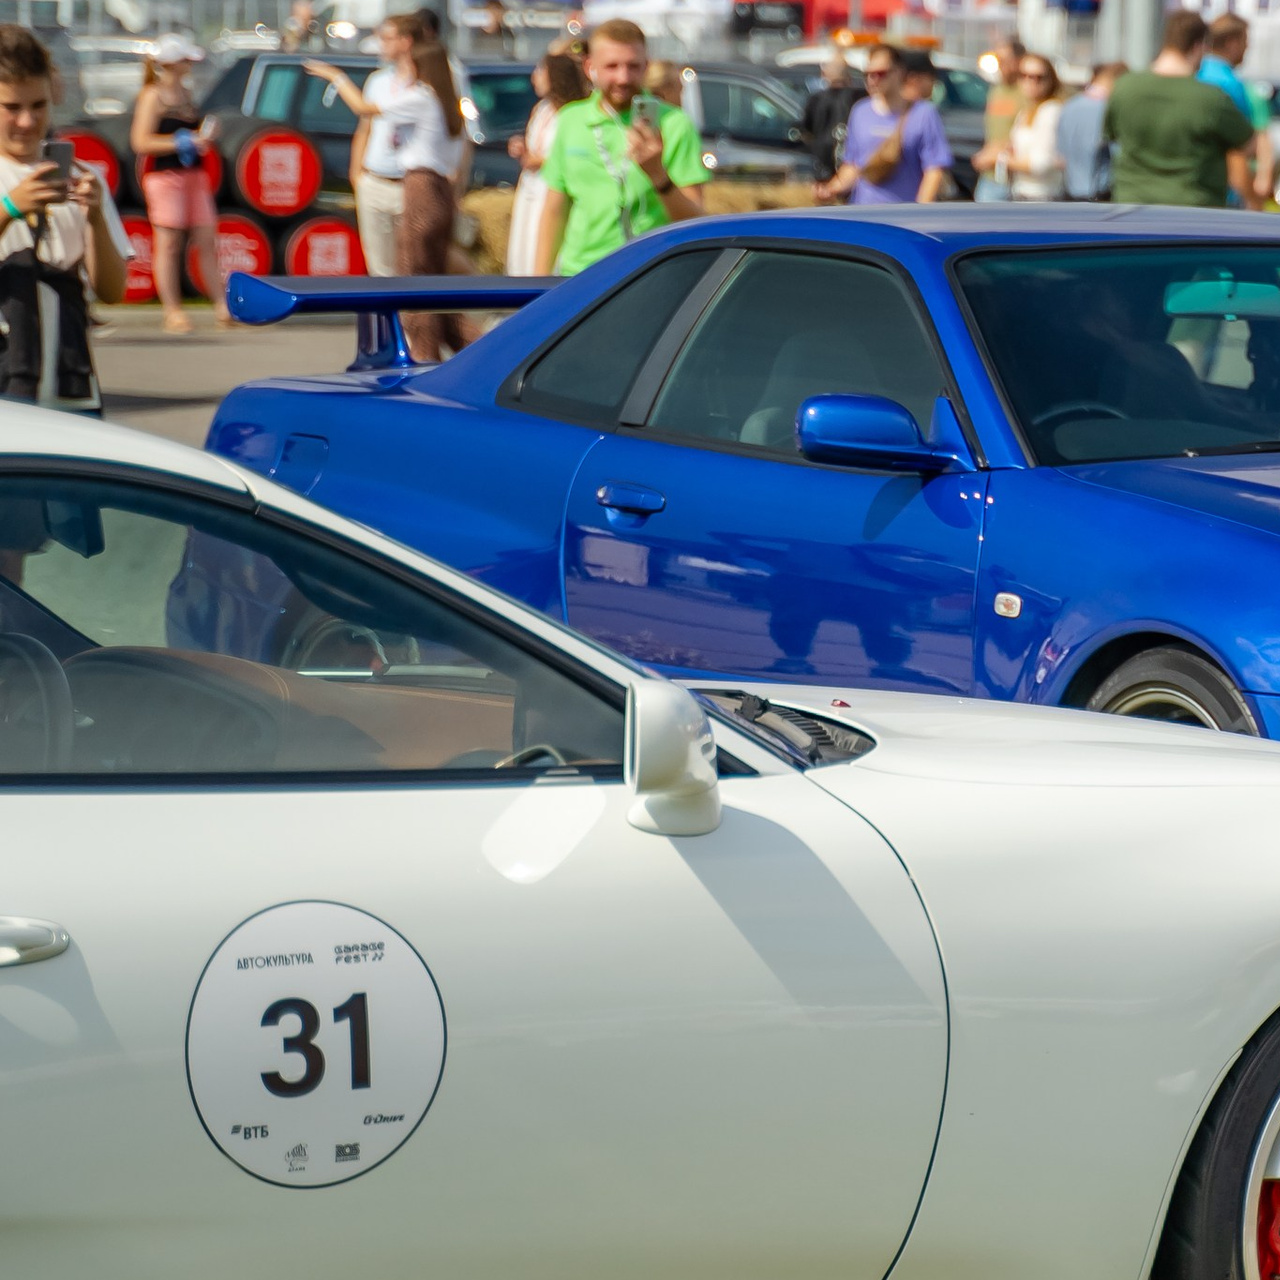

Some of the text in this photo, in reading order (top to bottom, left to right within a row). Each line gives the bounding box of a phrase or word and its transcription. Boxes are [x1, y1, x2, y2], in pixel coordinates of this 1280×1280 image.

[236, 952, 314, 970] АВТОКУЛЬТУРА
[259, 992, 371, 1098] 31
[243, 1125, 269, 1140] ВТБ
